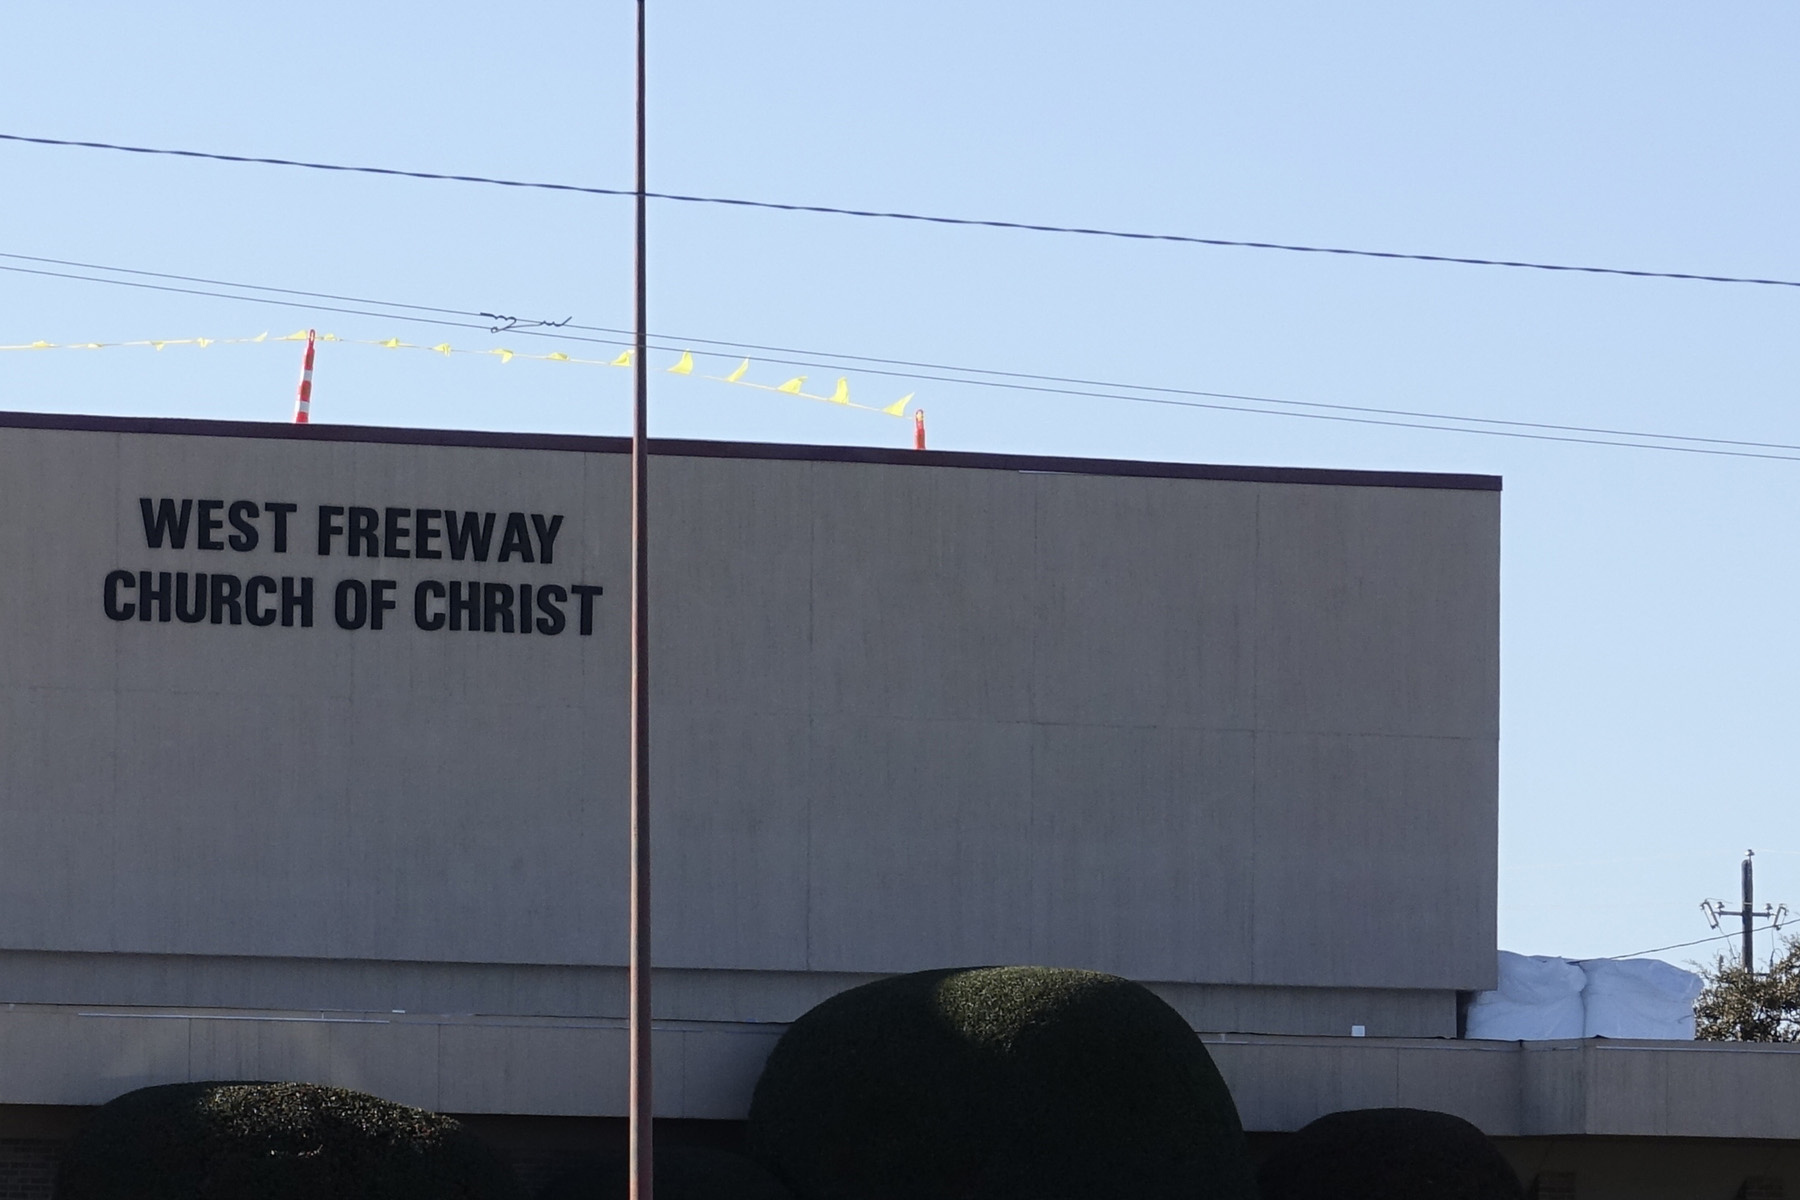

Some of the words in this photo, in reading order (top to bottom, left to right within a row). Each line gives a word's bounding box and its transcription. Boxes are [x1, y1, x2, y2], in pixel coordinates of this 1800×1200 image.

[139, 498, 298, 554] WEST
[317, 505, 564, 565] FREEWAY
[103, 570, 314, 629] CHURCH
[334, 579, 397, 631] OF
[414, 580, 604, 637] CHRIST
